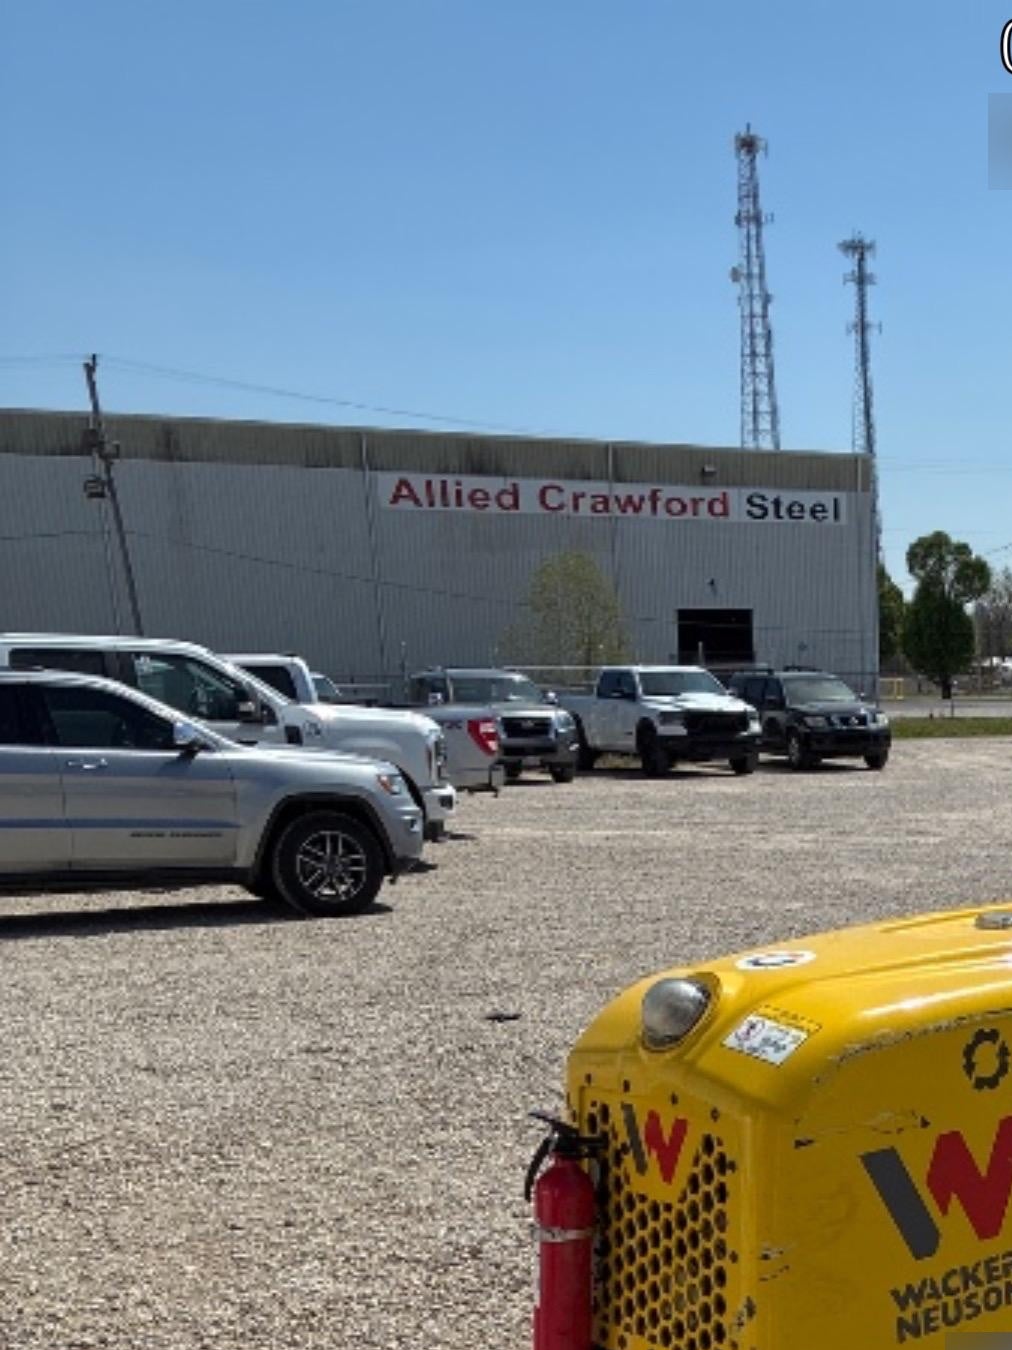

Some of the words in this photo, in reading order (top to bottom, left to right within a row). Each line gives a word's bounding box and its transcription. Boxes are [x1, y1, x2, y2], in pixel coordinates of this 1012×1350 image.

[388, 478, 520, 511] Allied
[538, 484, 730, 518] Crawford
[745, 492, 841, 522] Steel
